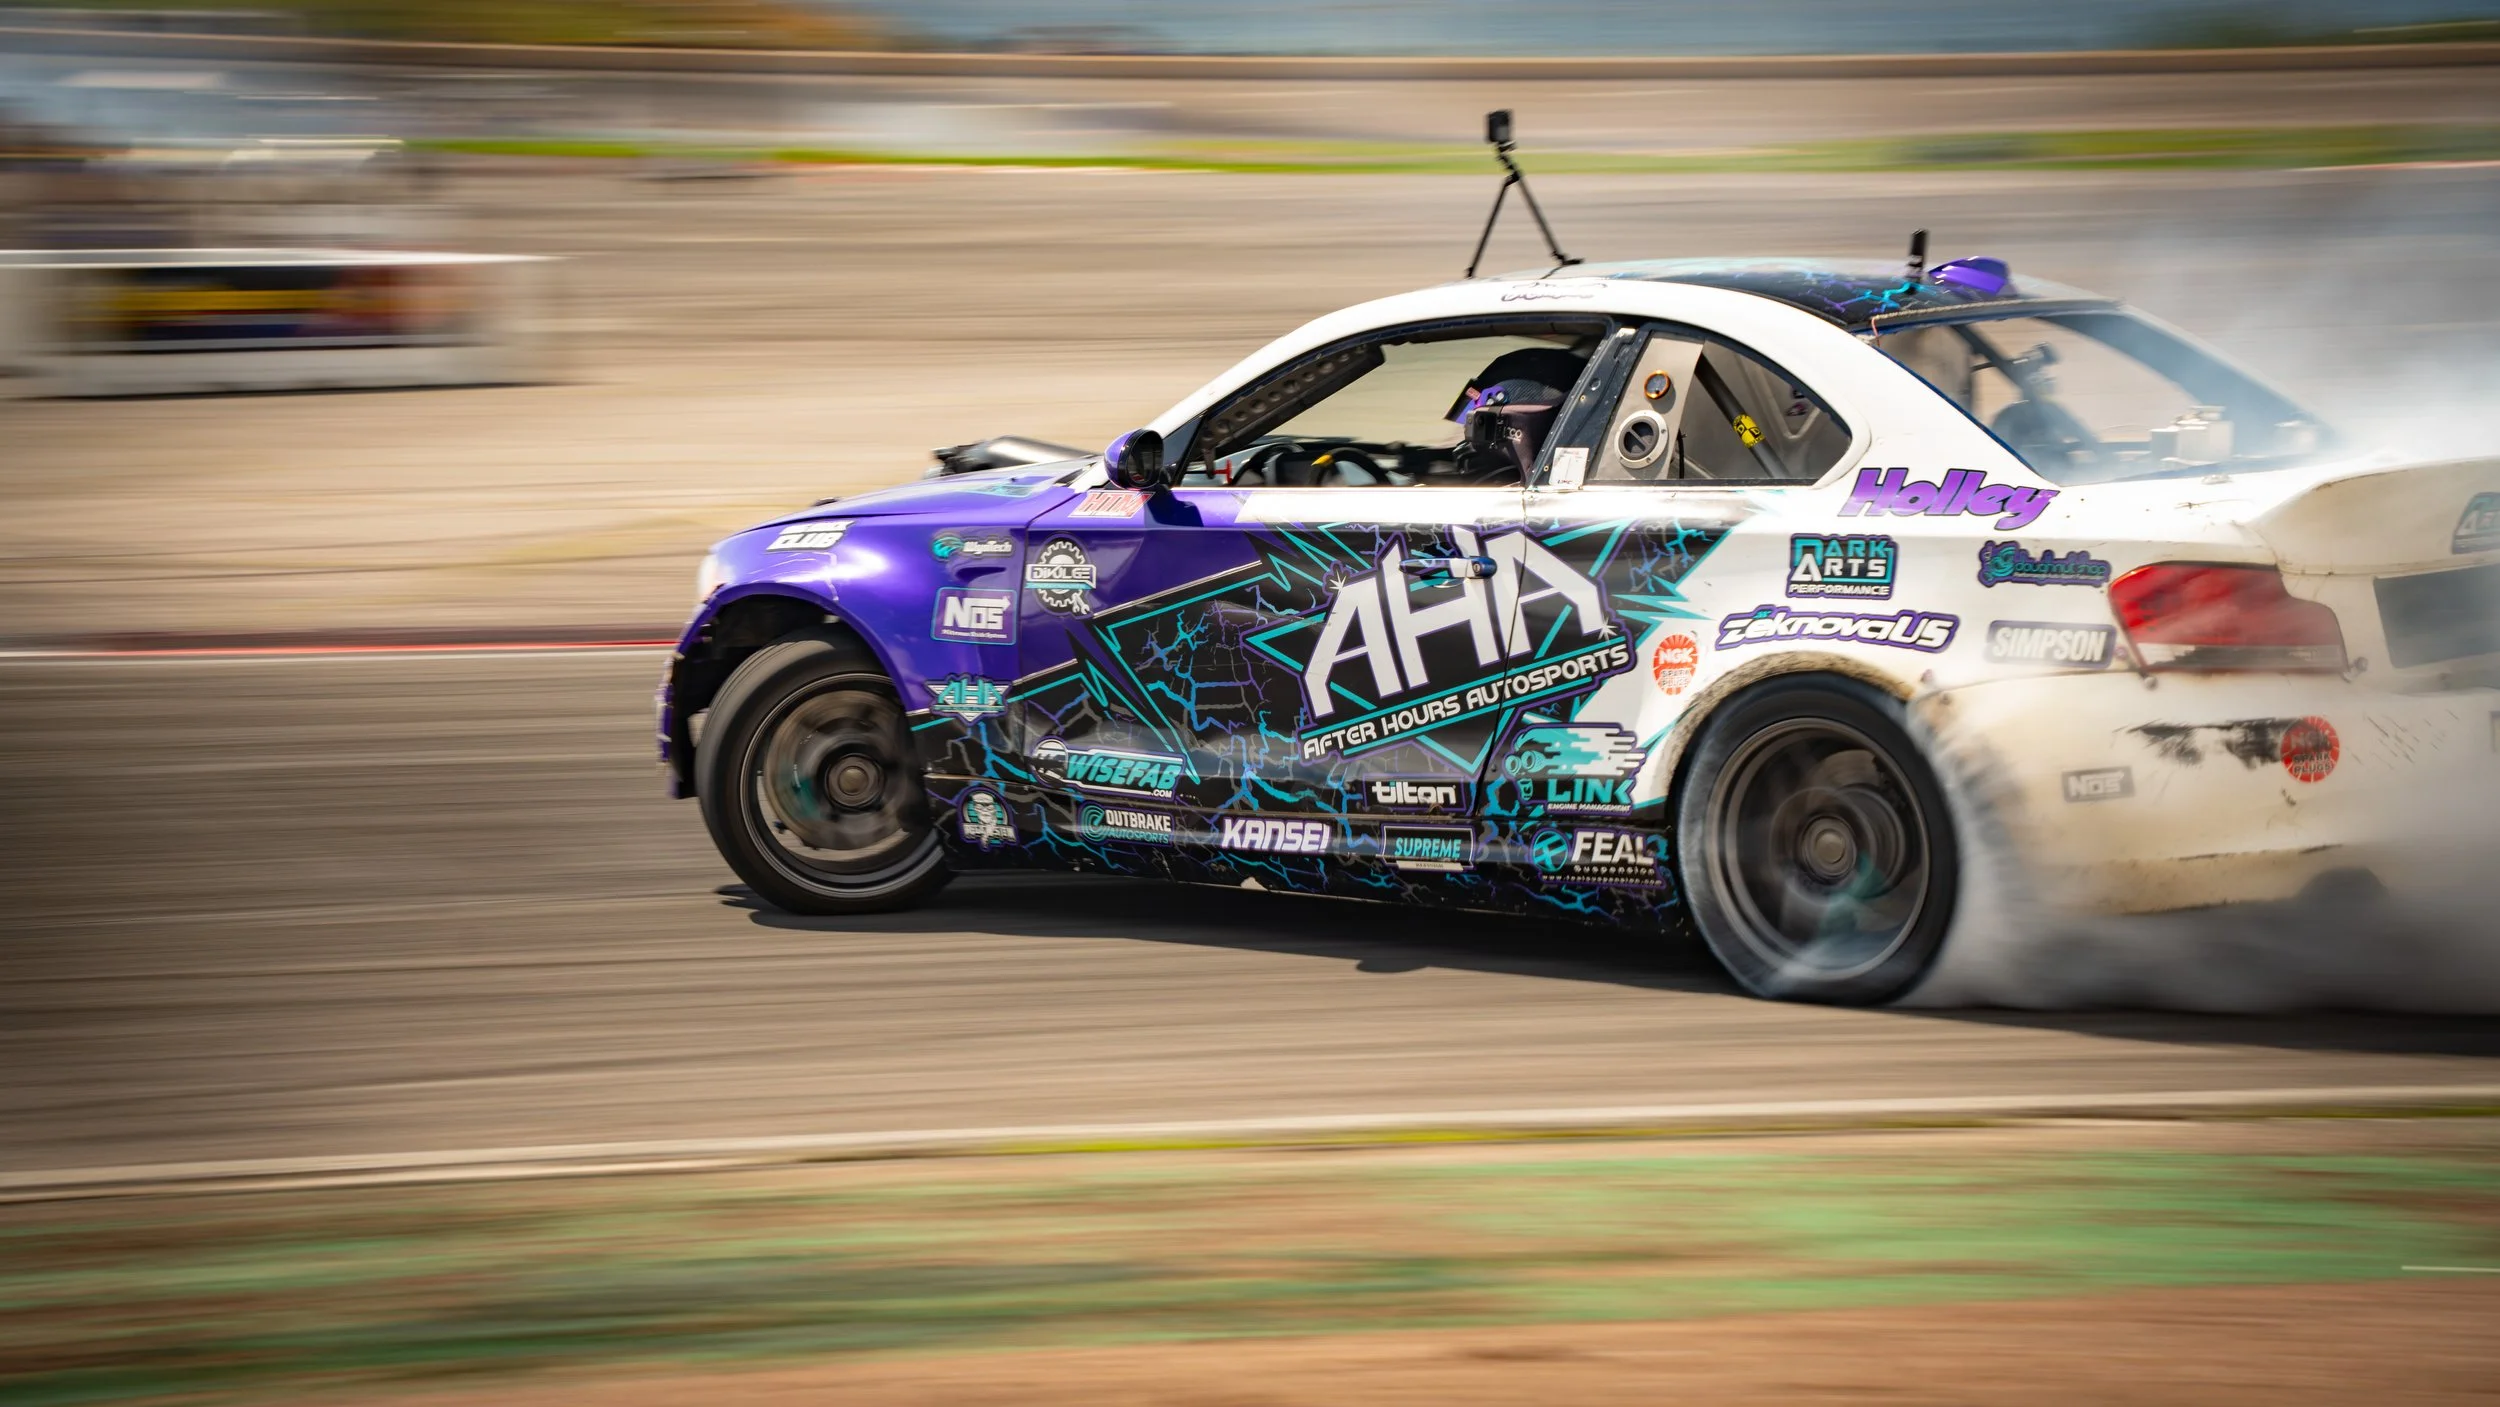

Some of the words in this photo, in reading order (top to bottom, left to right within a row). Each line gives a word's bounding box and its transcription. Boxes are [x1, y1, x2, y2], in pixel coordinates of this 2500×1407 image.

[1837, 468, 2060, 530] Holley
[1794, 539, 1888, 566] DARK
[1791, 553, 1887, 582] ARTS
[1789, 584, 1889, 595] PERFORMANCE
[943, 596, 1011, 629] NOS
[1304, 525, 1607, 718] AHA
[1659, 648, 1694, 664] NGK
[1993, 627, 2108, 661] SIMPSON
[938, 679, 1003, 705] AHA
[1304, 723, 1377, 759] AFTER
[1382, 697, 1461, 738] HOURS
[1466, 644, 1629, 711] AUTOSPORTS
[2293, 753, 2330, 763] SPARK
[2294, 763, 2331, 774] PLUGS
[1067, 753, 1182, 790] WISEFAB
[2068, 771, 2125, 796] NOS
[1372, 781, 1456, 804] tilton
[1548, 778, 1634, 804] LINK
[1106, 810, 1172, 832] OUTBRAKE
[1579, 804, 1632, 812] MANAGEMENT
[1221, 818, 1331, 853] KANSEI
[1394, 836, 1461, 859] SUPREME
[1571, 831, 1654, 865] FEAL
[1574, 865, 1655, 876] Suspension
